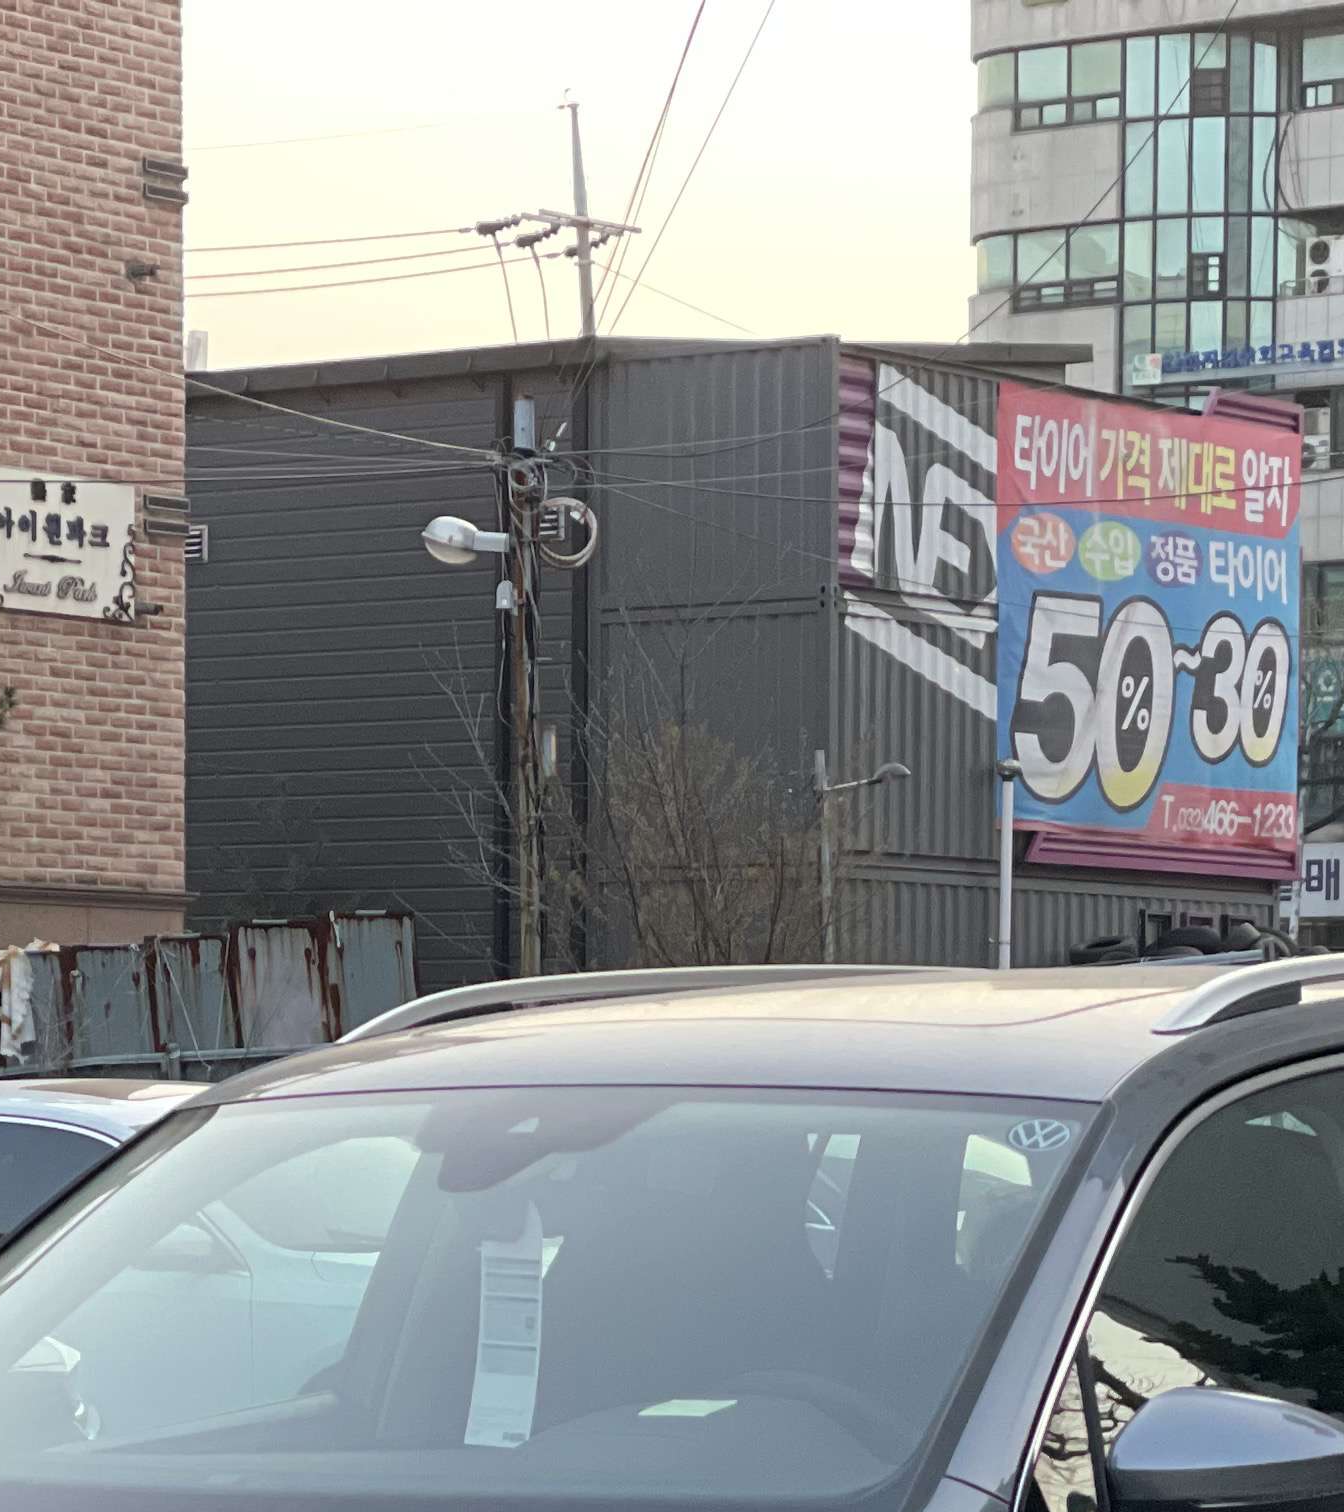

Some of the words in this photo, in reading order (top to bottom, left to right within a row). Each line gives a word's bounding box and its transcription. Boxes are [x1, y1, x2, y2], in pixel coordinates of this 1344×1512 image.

[1014, 414, 1096, 498] 타이어
[1099, 428, 1152, 506] 가격
[1157, 436, 1238, 516] 제대로
[1241, 447, 1294, 528] 알자
[1016, 517, 1070, 570] 국산
[1085, 524, 1137, 577] 수입
[1150, 535, 1198, 586] 정품
[1208, 540, 1290, 605] 타이어
